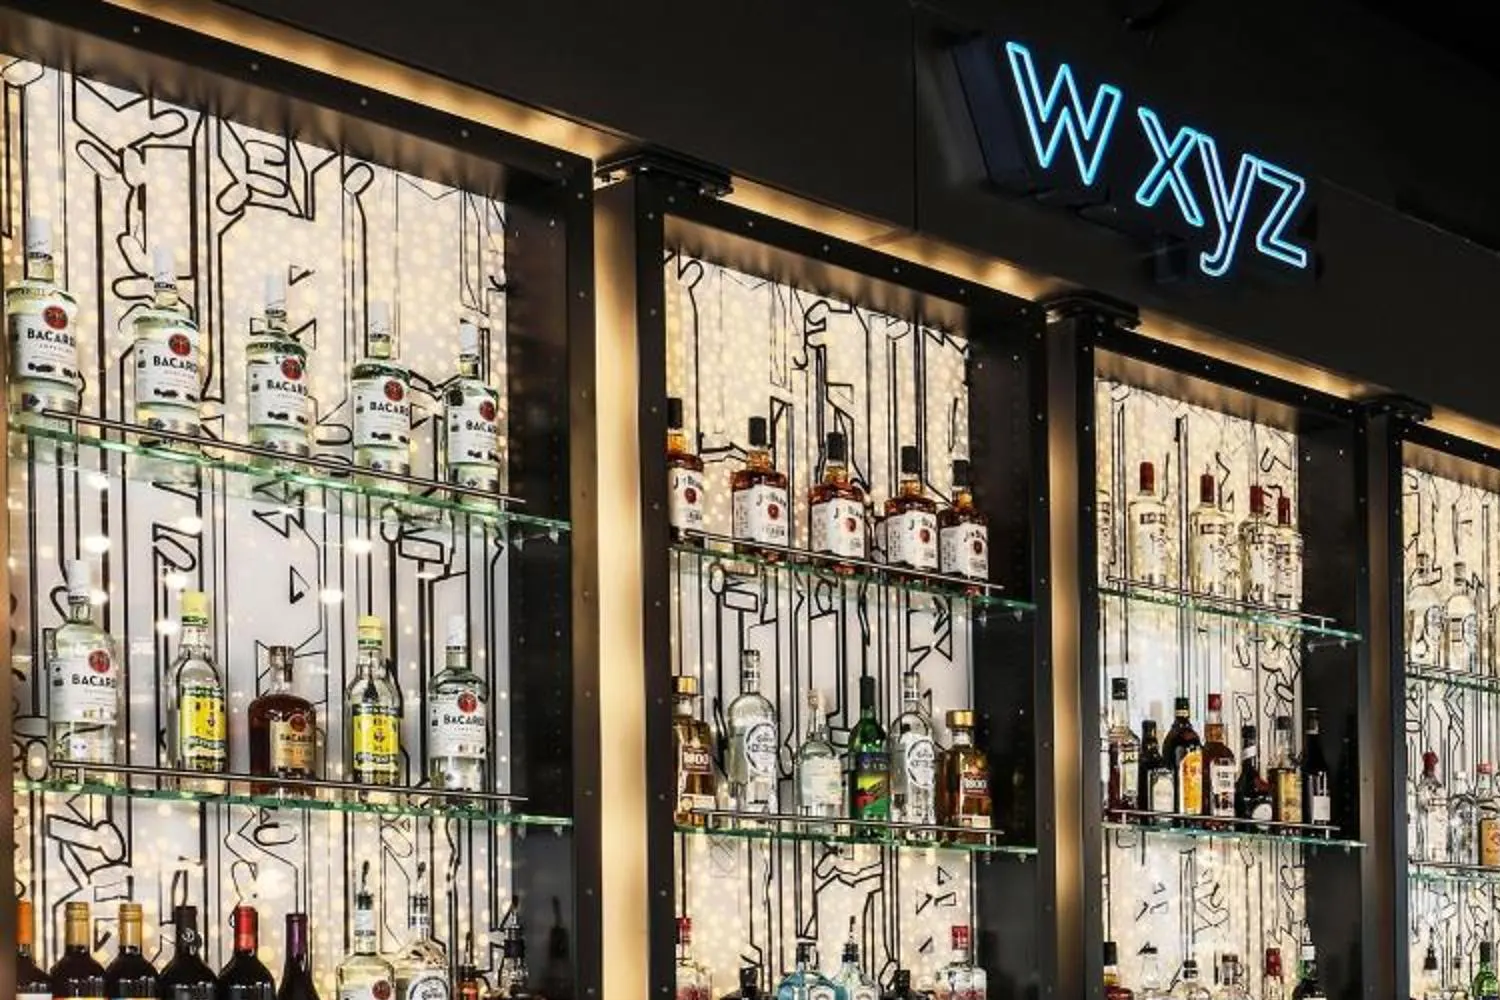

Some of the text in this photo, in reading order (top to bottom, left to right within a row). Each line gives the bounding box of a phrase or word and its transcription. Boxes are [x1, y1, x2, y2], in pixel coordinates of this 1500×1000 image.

[1005, 41, 1308, 277] W xyz
[27, 327, 76, 347] BACARD
[154, 355, 197, 372] BACARD
[71, 673, 116, 689] BACARD
